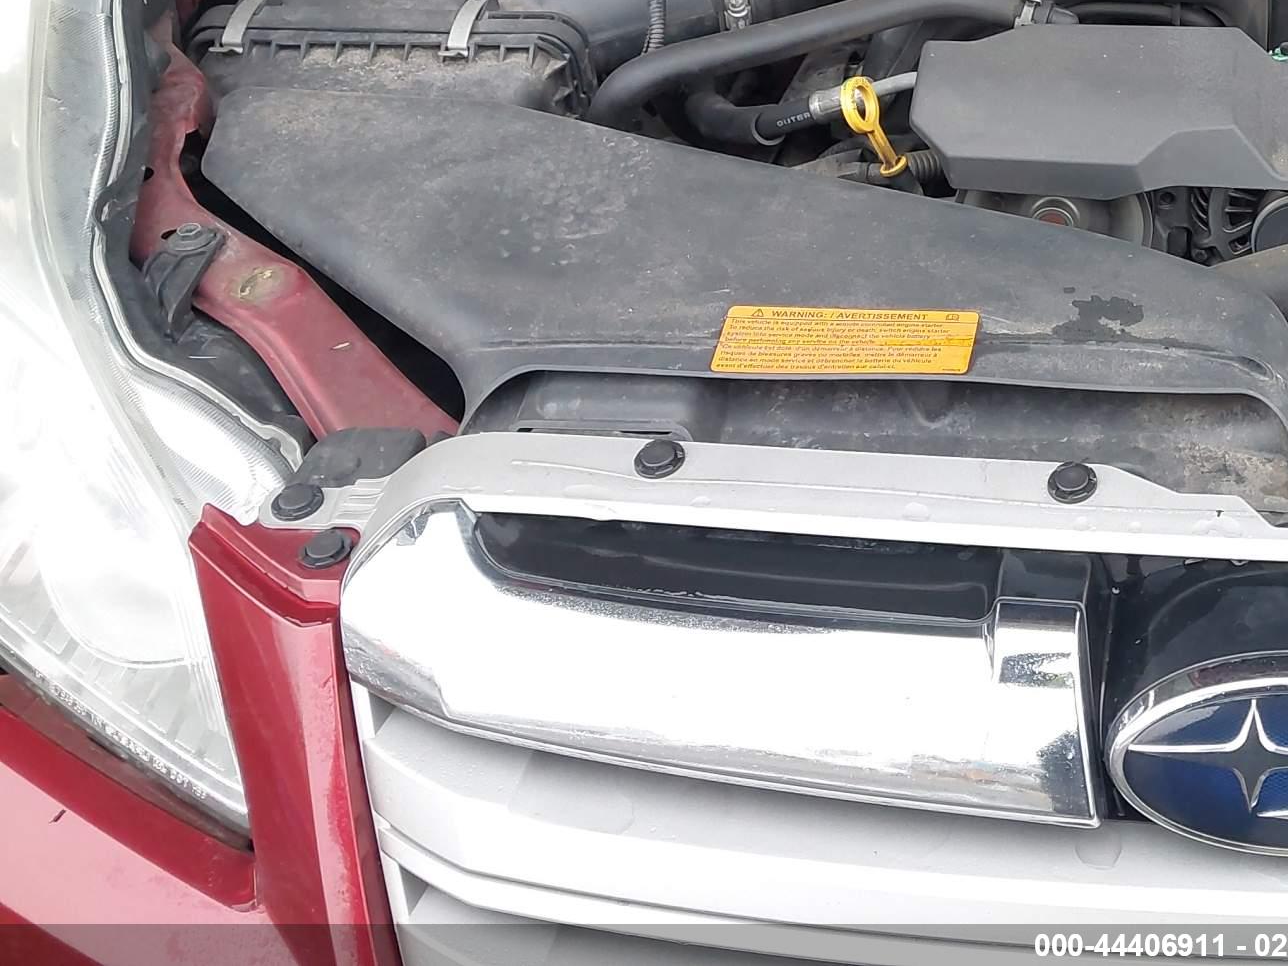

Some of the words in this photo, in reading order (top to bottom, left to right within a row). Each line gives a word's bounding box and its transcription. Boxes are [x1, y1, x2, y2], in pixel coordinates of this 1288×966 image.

[776, 112, 811, 127] OUTER
[770, 310, 827, 318] WARNING:
[835, 312, 928, 321] AVERTISSEMENT
